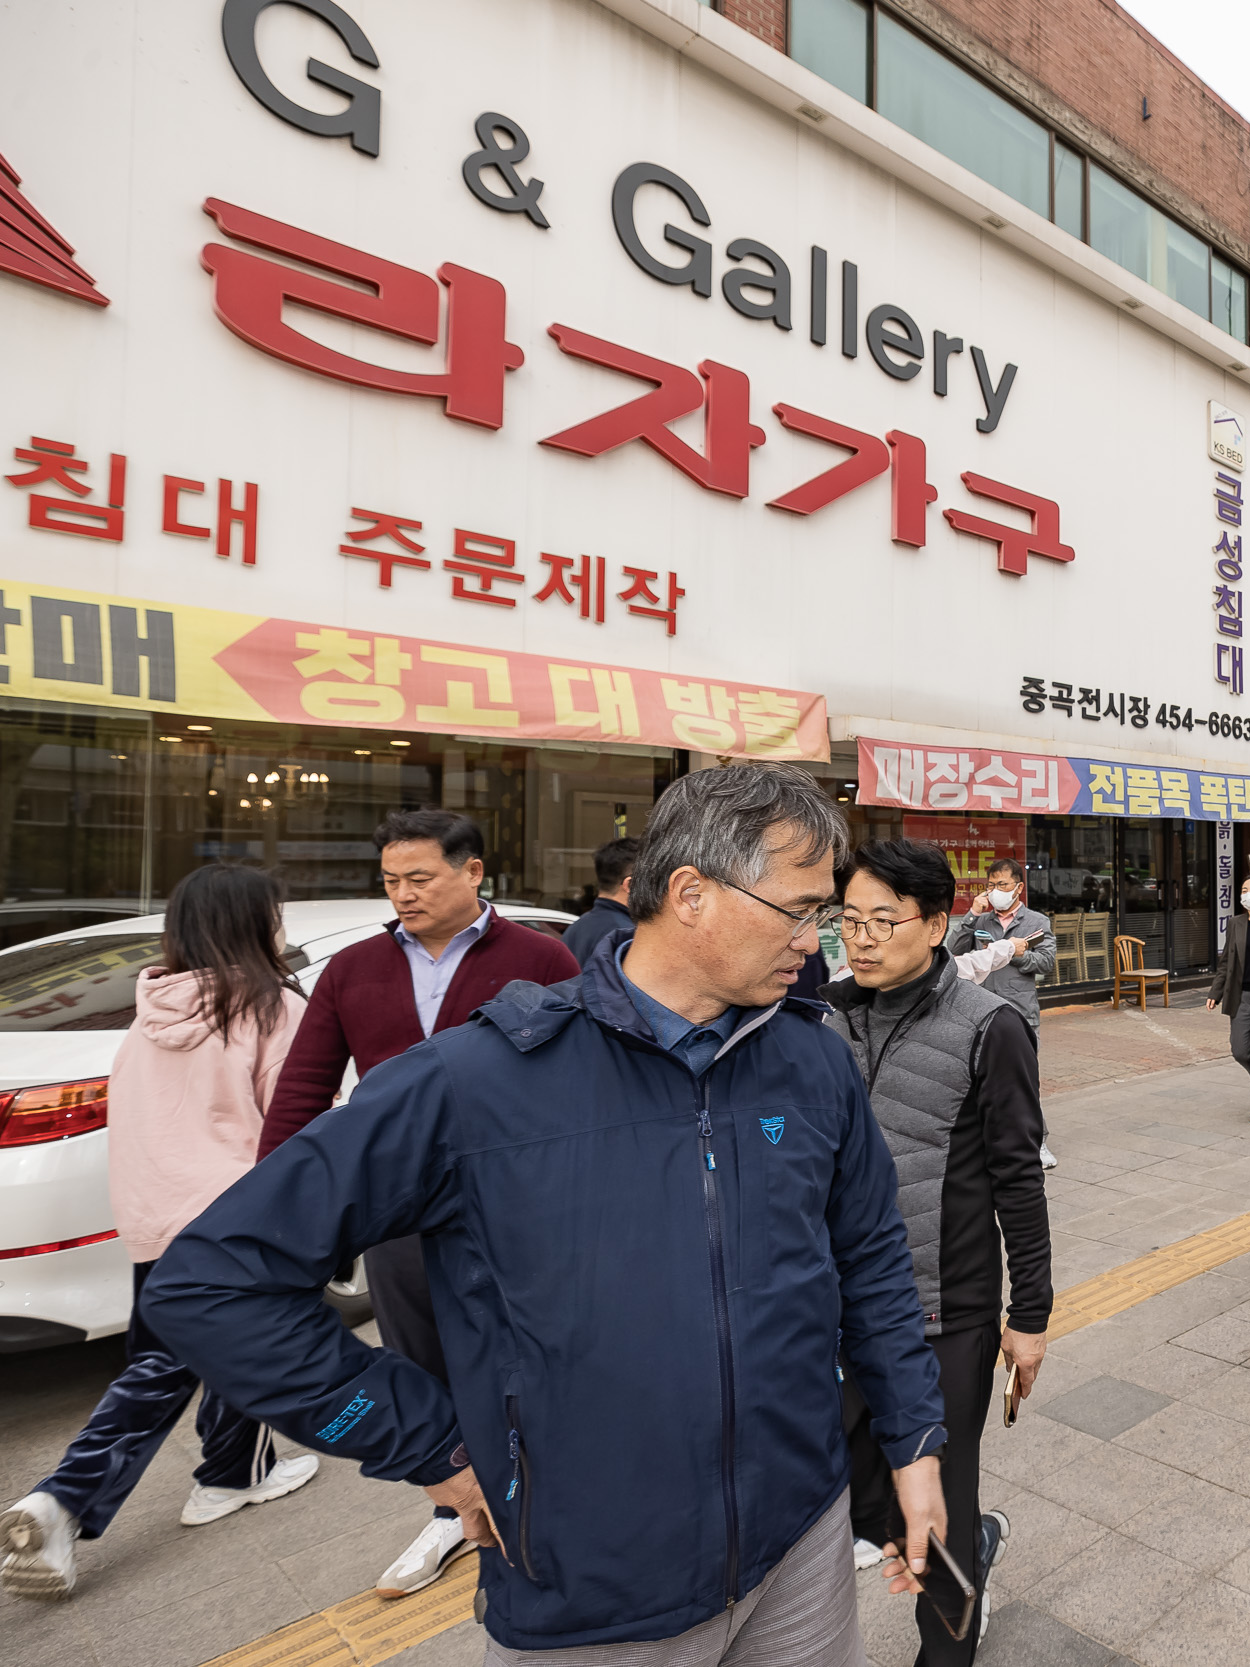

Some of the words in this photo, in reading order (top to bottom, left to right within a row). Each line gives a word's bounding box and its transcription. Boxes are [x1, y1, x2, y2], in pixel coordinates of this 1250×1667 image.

[222, 0, 381, 158] G
[462, 112, 551, 229] &
[611, 161, 1018, 433] Gallery
[200, 196, 1076, 577] 라자가구
[1212, 440, 1225, 456] KS
[1226, 447, 1243, 464] BED
[339, 506, 687, 637] 주문제작
[1212, 470, 1244, 696] 금성침대
[292, 627, 520, 729] 창고
[1020, 676, 1151, 729] 중곡전시장
[873, 746, 1060, 812] 매장수리
[1088, 763, 1192, 818] 전품목
[945, 850, 995, 878] ALE
